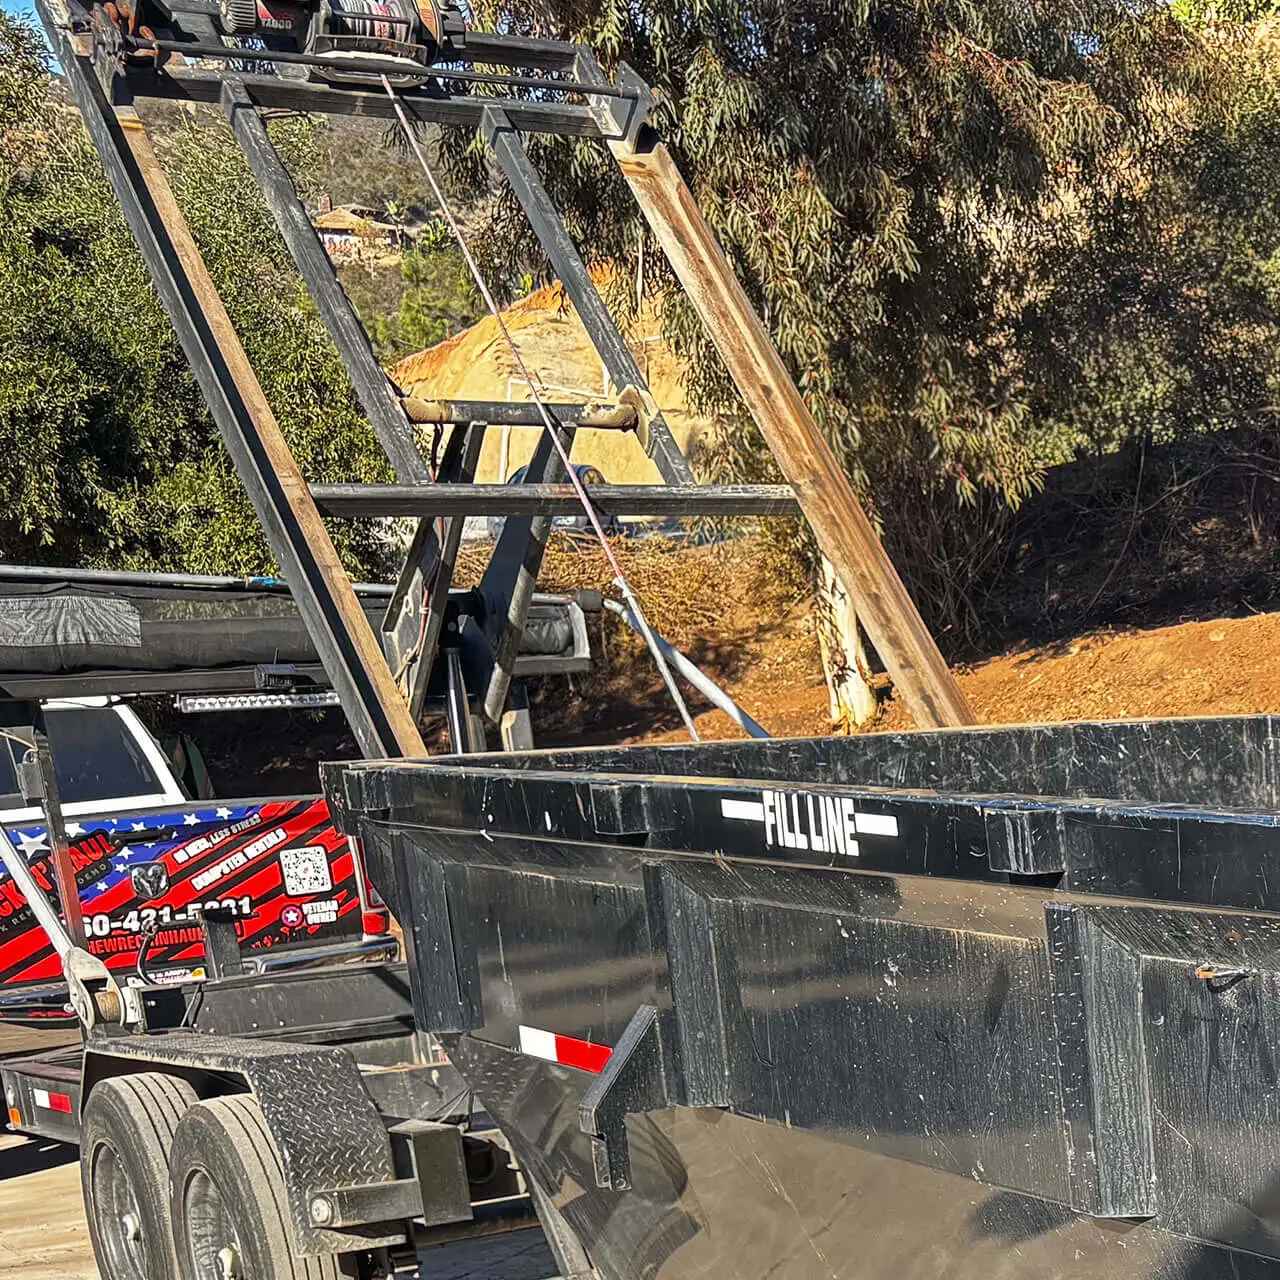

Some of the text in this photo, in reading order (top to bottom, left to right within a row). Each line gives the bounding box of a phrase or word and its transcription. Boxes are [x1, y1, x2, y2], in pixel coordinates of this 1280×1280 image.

[762, 790, 860, 857] FILL LINE
[48, 834, 116, 874] AUL
[77, 863, 107, 885] DEMO
